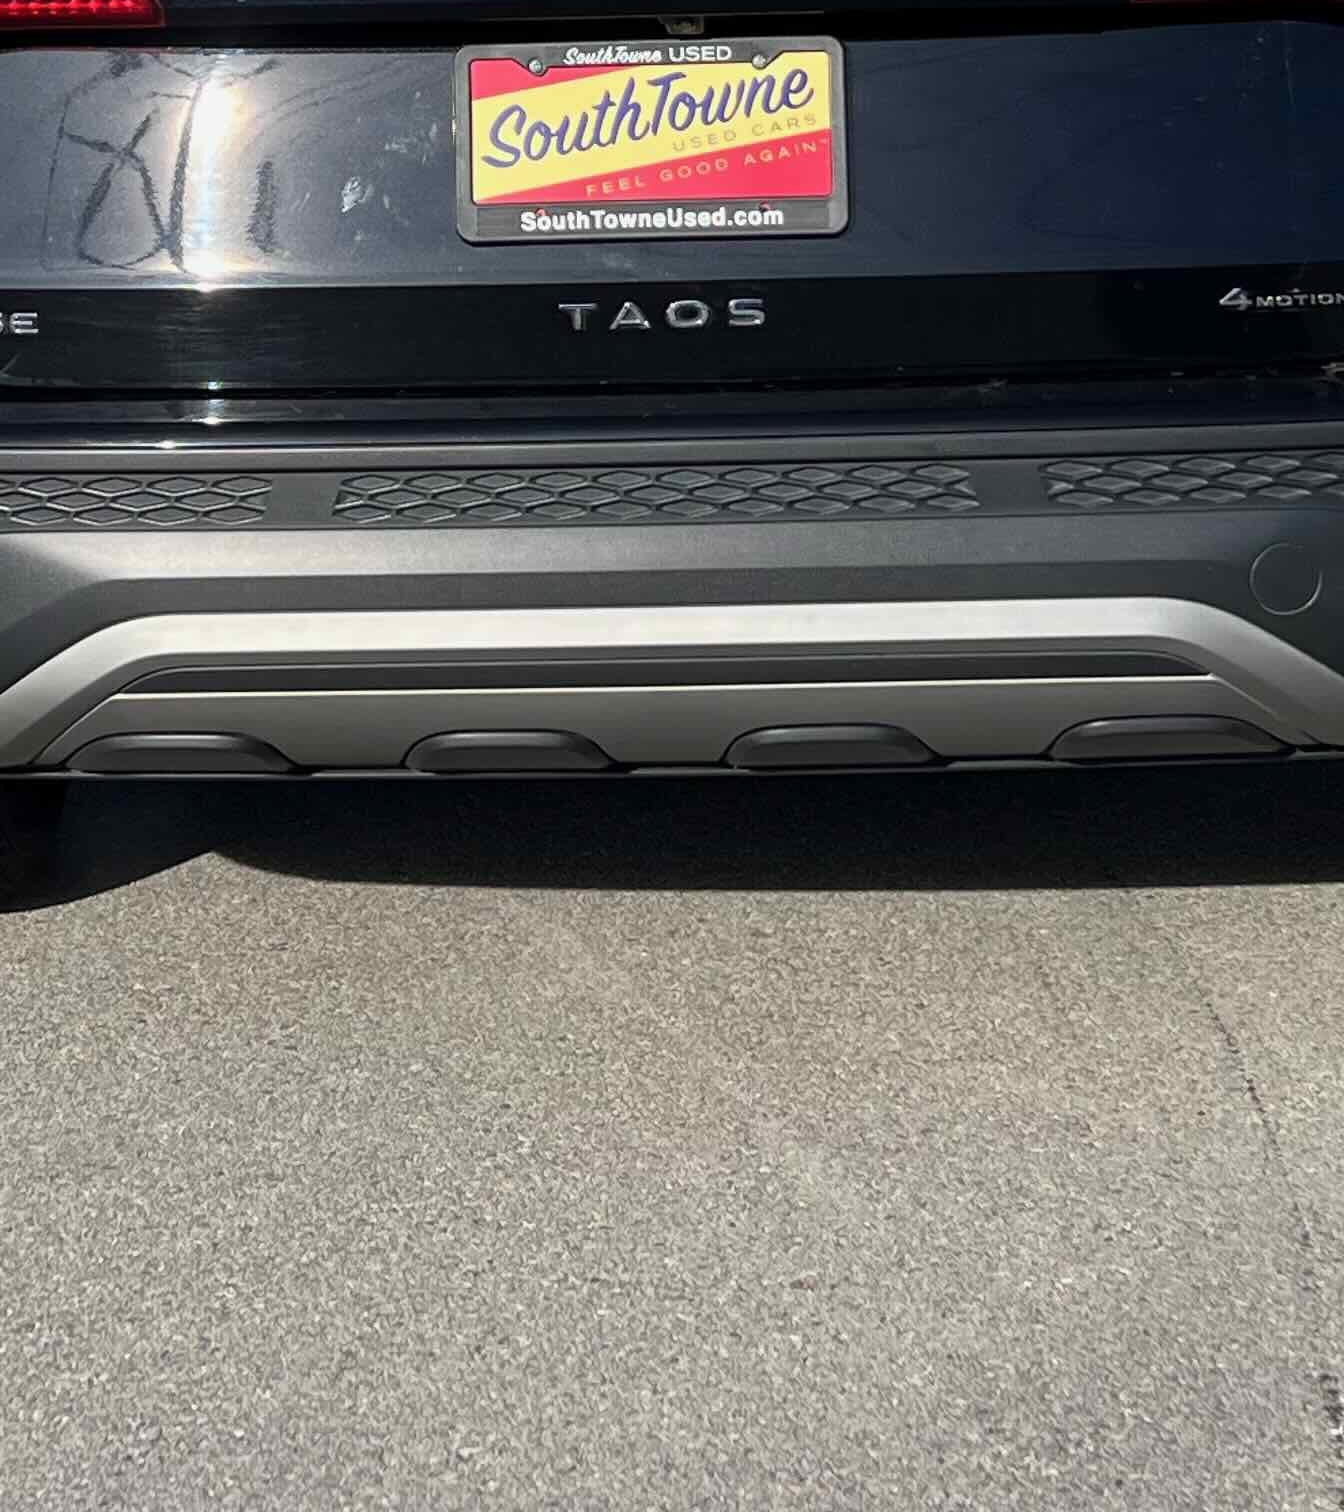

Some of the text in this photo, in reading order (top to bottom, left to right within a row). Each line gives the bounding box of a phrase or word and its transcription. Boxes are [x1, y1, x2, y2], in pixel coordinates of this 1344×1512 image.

[563, 45, 733, 65] SouthTowne USED
[482, 67, 815, 169] SouthTowne
[672, 113, 818, 152] USED CARS
[585, 177, 646, 197] FEEL
[659, 158, 729, 182] GOOD
[519, 208, 784, 233] SouthTowneUsed.com
[558, 297, 767, 332] TAOS
